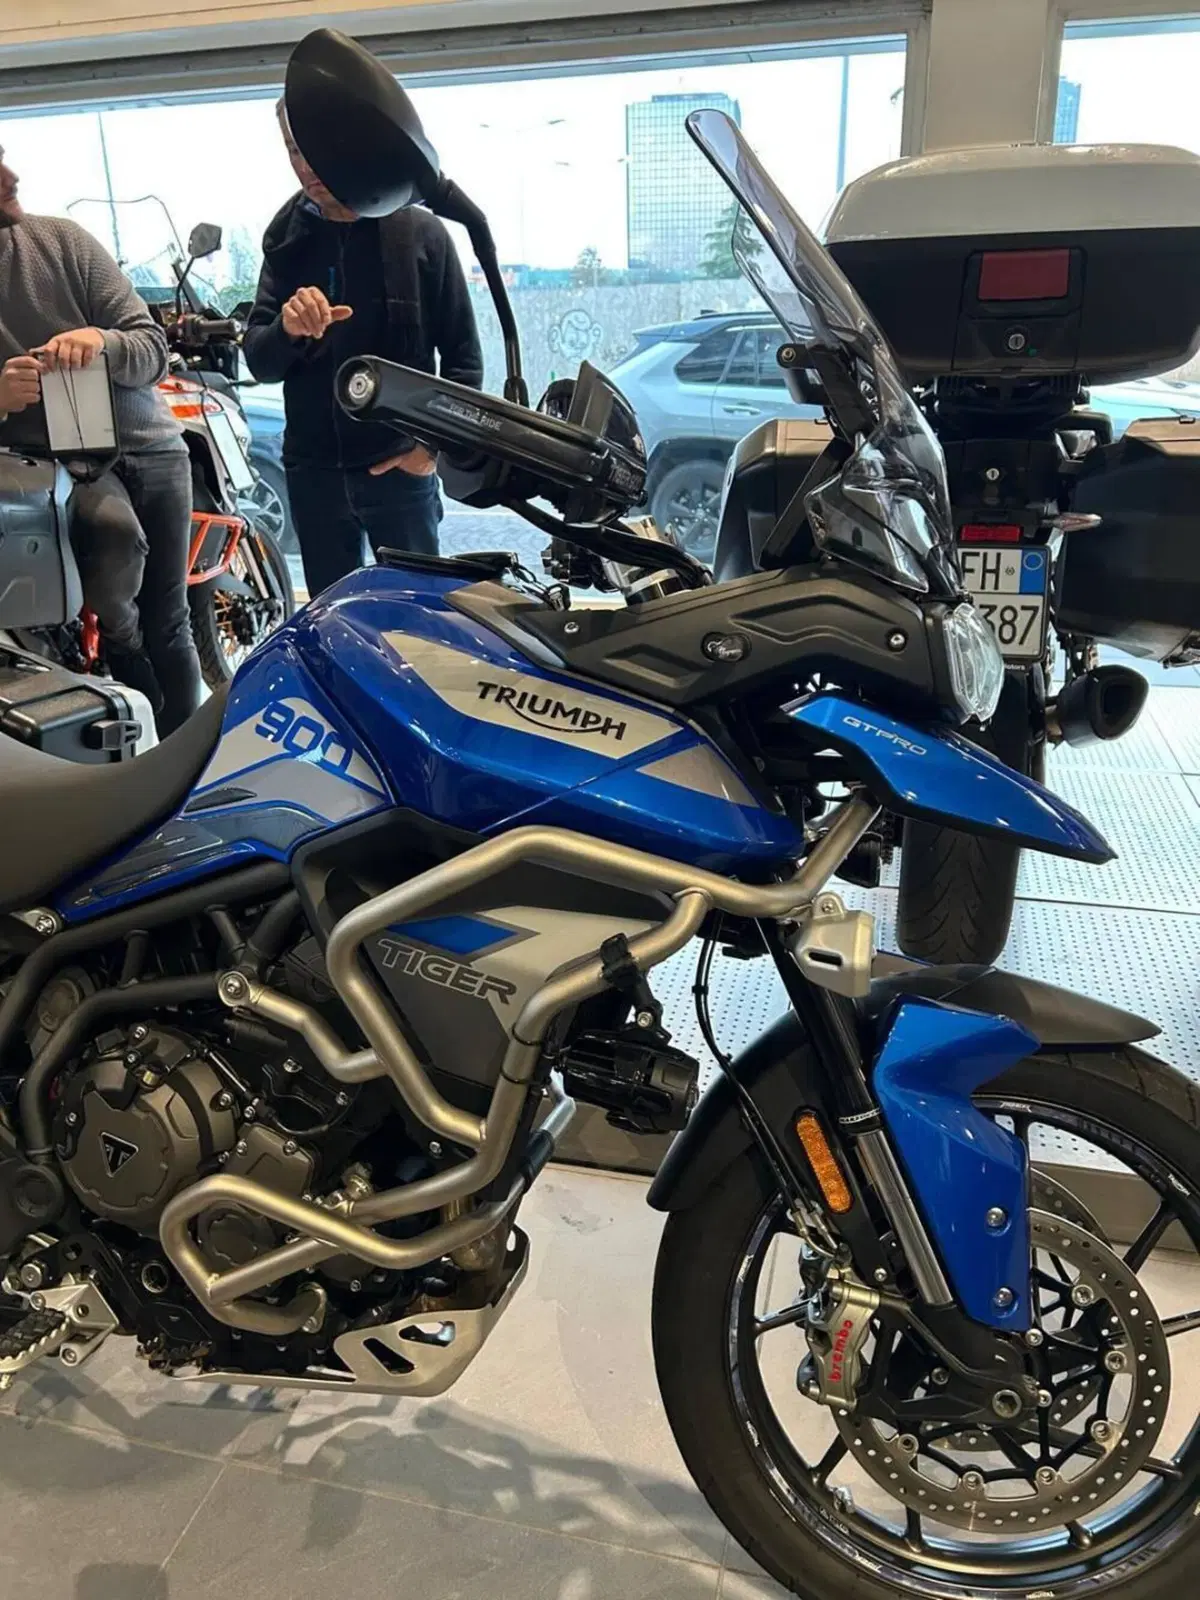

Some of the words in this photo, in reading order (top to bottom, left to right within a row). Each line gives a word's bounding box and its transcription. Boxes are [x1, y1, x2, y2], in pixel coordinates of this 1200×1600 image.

[480, 414, 502, 431] RIDE
[961, 551, 1001, 590] FH
[255, 700, 353, 776] 900
[477, 681, 627, 741] TRIUMPH
[378, 938, 517, 1006] TIGER
[827, 1319, 854, 1383] brembo
